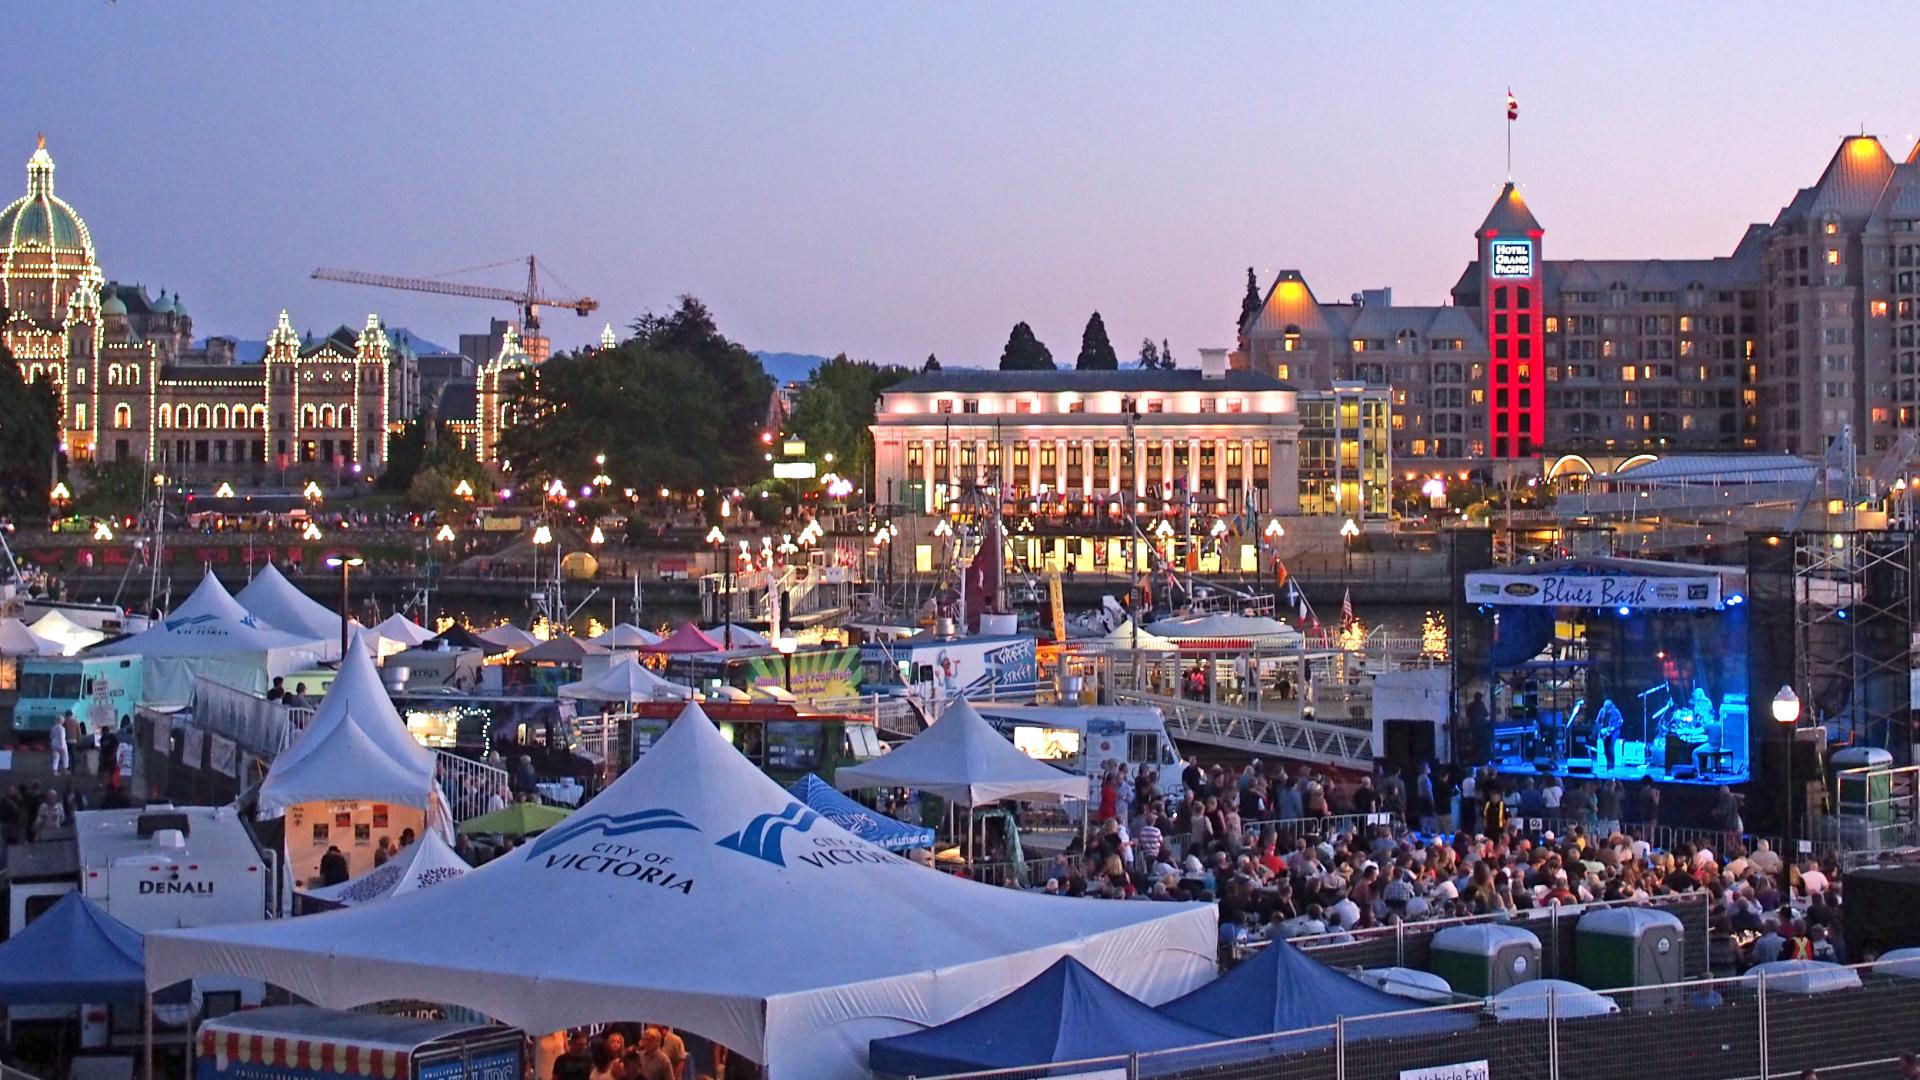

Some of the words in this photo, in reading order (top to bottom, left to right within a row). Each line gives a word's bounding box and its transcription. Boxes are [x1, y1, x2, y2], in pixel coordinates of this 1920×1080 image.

[1495, 255, 1529, 265] GRAND
[1495, 264, 1529, 274] PACIFIC
[1542, 577, 1593, 604] Blues
[1600, 578, 1647, 606] Bash
[998, 639, 1032, 664] GREEK
[1003, 664, 1031, 685] STREET
[813, 836, 847, 848] CITY
[592, 843, 639, 857] CITY
[644, 853, 673, 865] OF
[545, 853, 694, 895] VICTORIA
[139, 880, 214, 894] DENALI
[1419, 1071, 1462, 1080] hile
[1465, 1068, 1486, 1080] Exit
